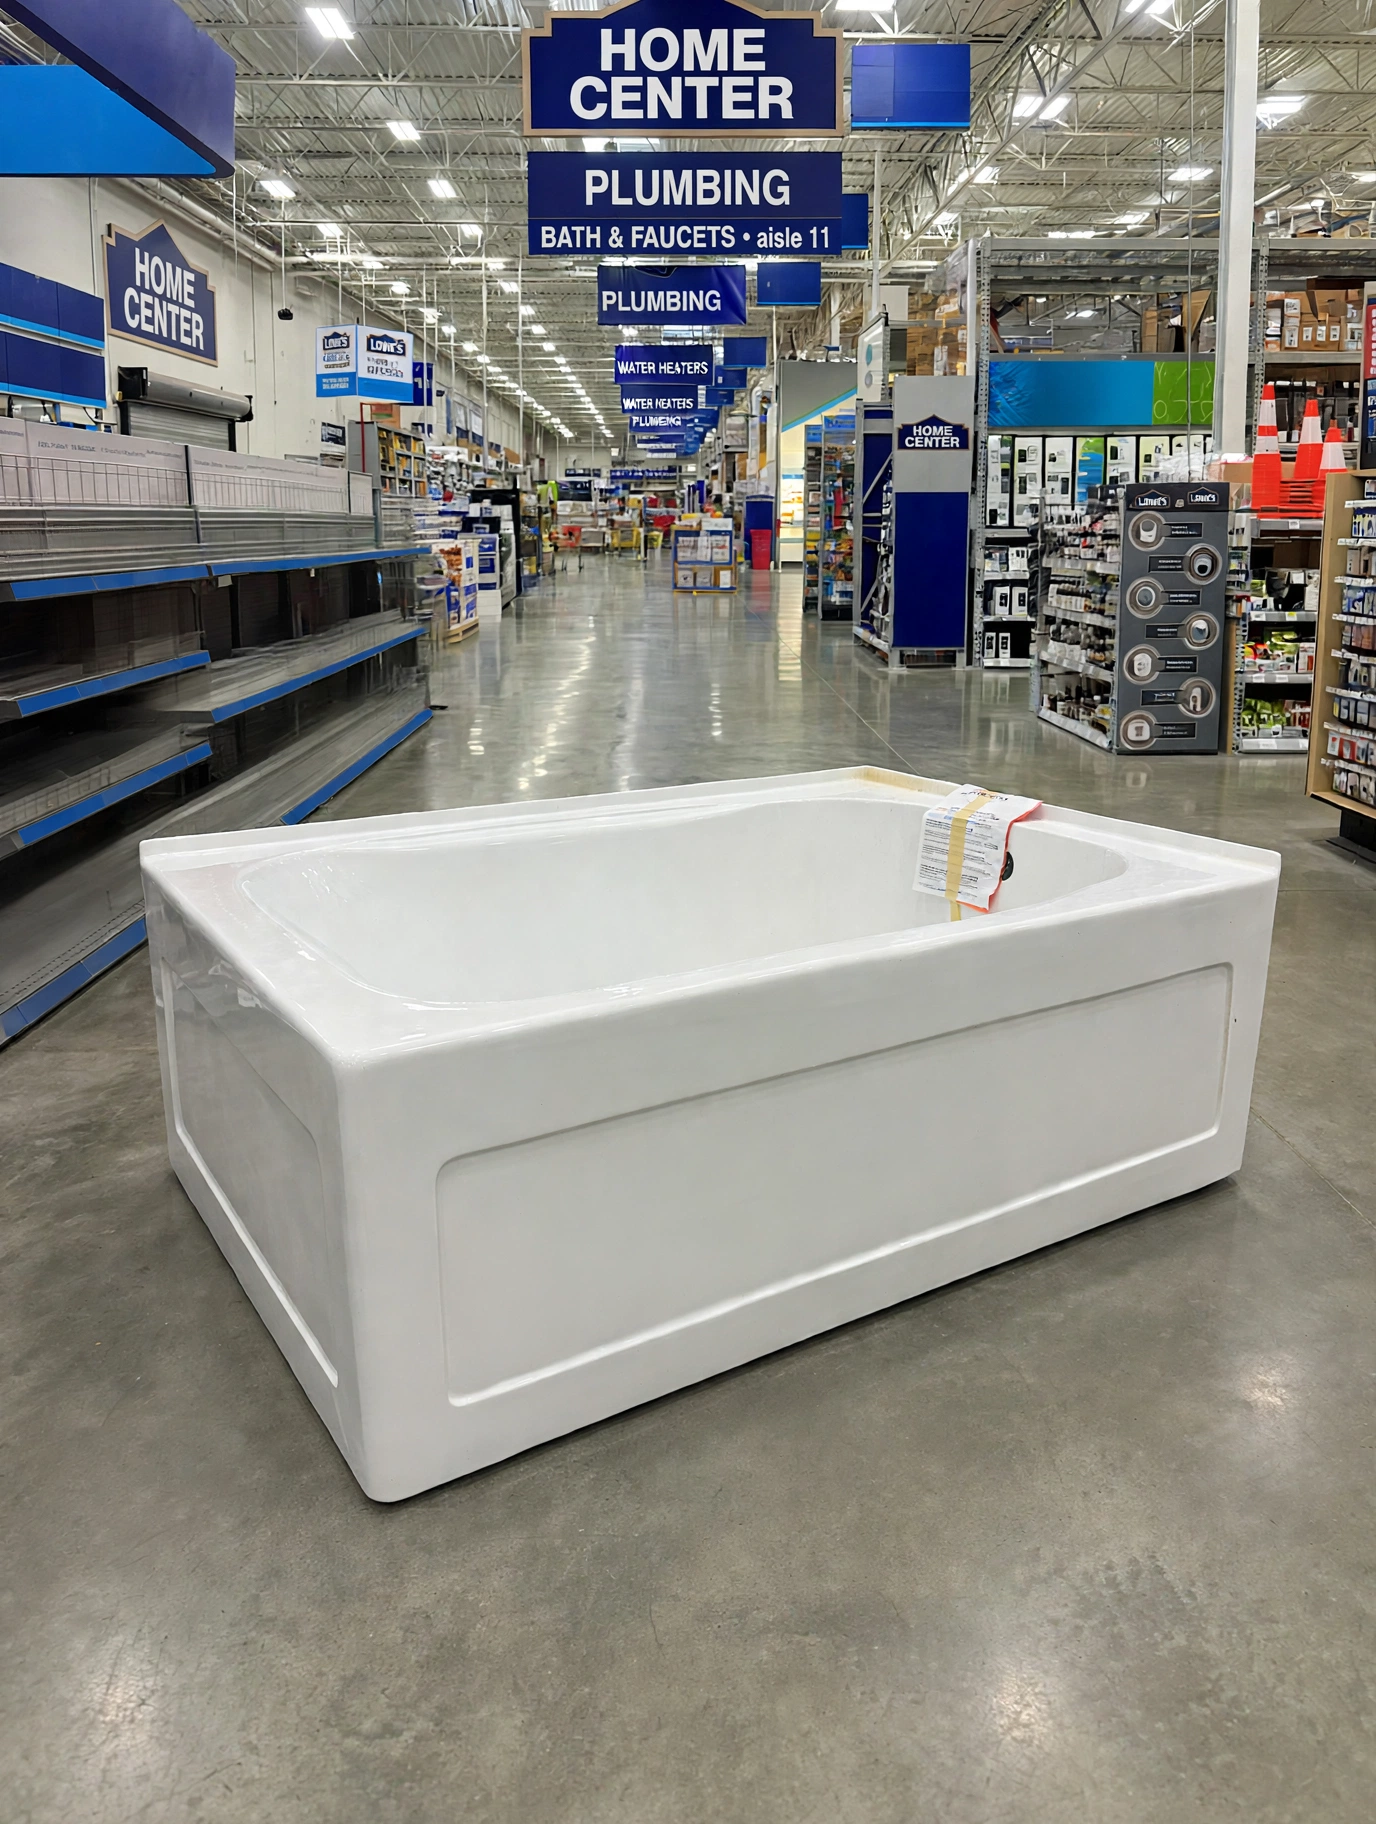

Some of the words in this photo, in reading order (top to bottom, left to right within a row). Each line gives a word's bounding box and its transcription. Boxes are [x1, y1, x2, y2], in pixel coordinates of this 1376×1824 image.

[601, 28, 765, 71] HOME
[570, 76, 793, 119] CENTER
[585, 169, 789, 205] PLUMBING
[541, 226, 600, 248] BATH
[608, 226, 624, 248] &
[631, 225, 735, 248] FAUCETS
[757, 227, 802, 248] aisle
[809, 226, 829, 248] 11
[135, 247, 195, 308] HOME
[602, 290, 721, 312] PLUMBING
[124, 287, 204, 350] CENTER
[617, 361, 656, 375] WATER
[658, 361, 709, 375] HEATERS
[622, 398, 653, 410] WATER
[904, 436, 960, 448] CENTER
[913, 425, 953, 436] HOME
